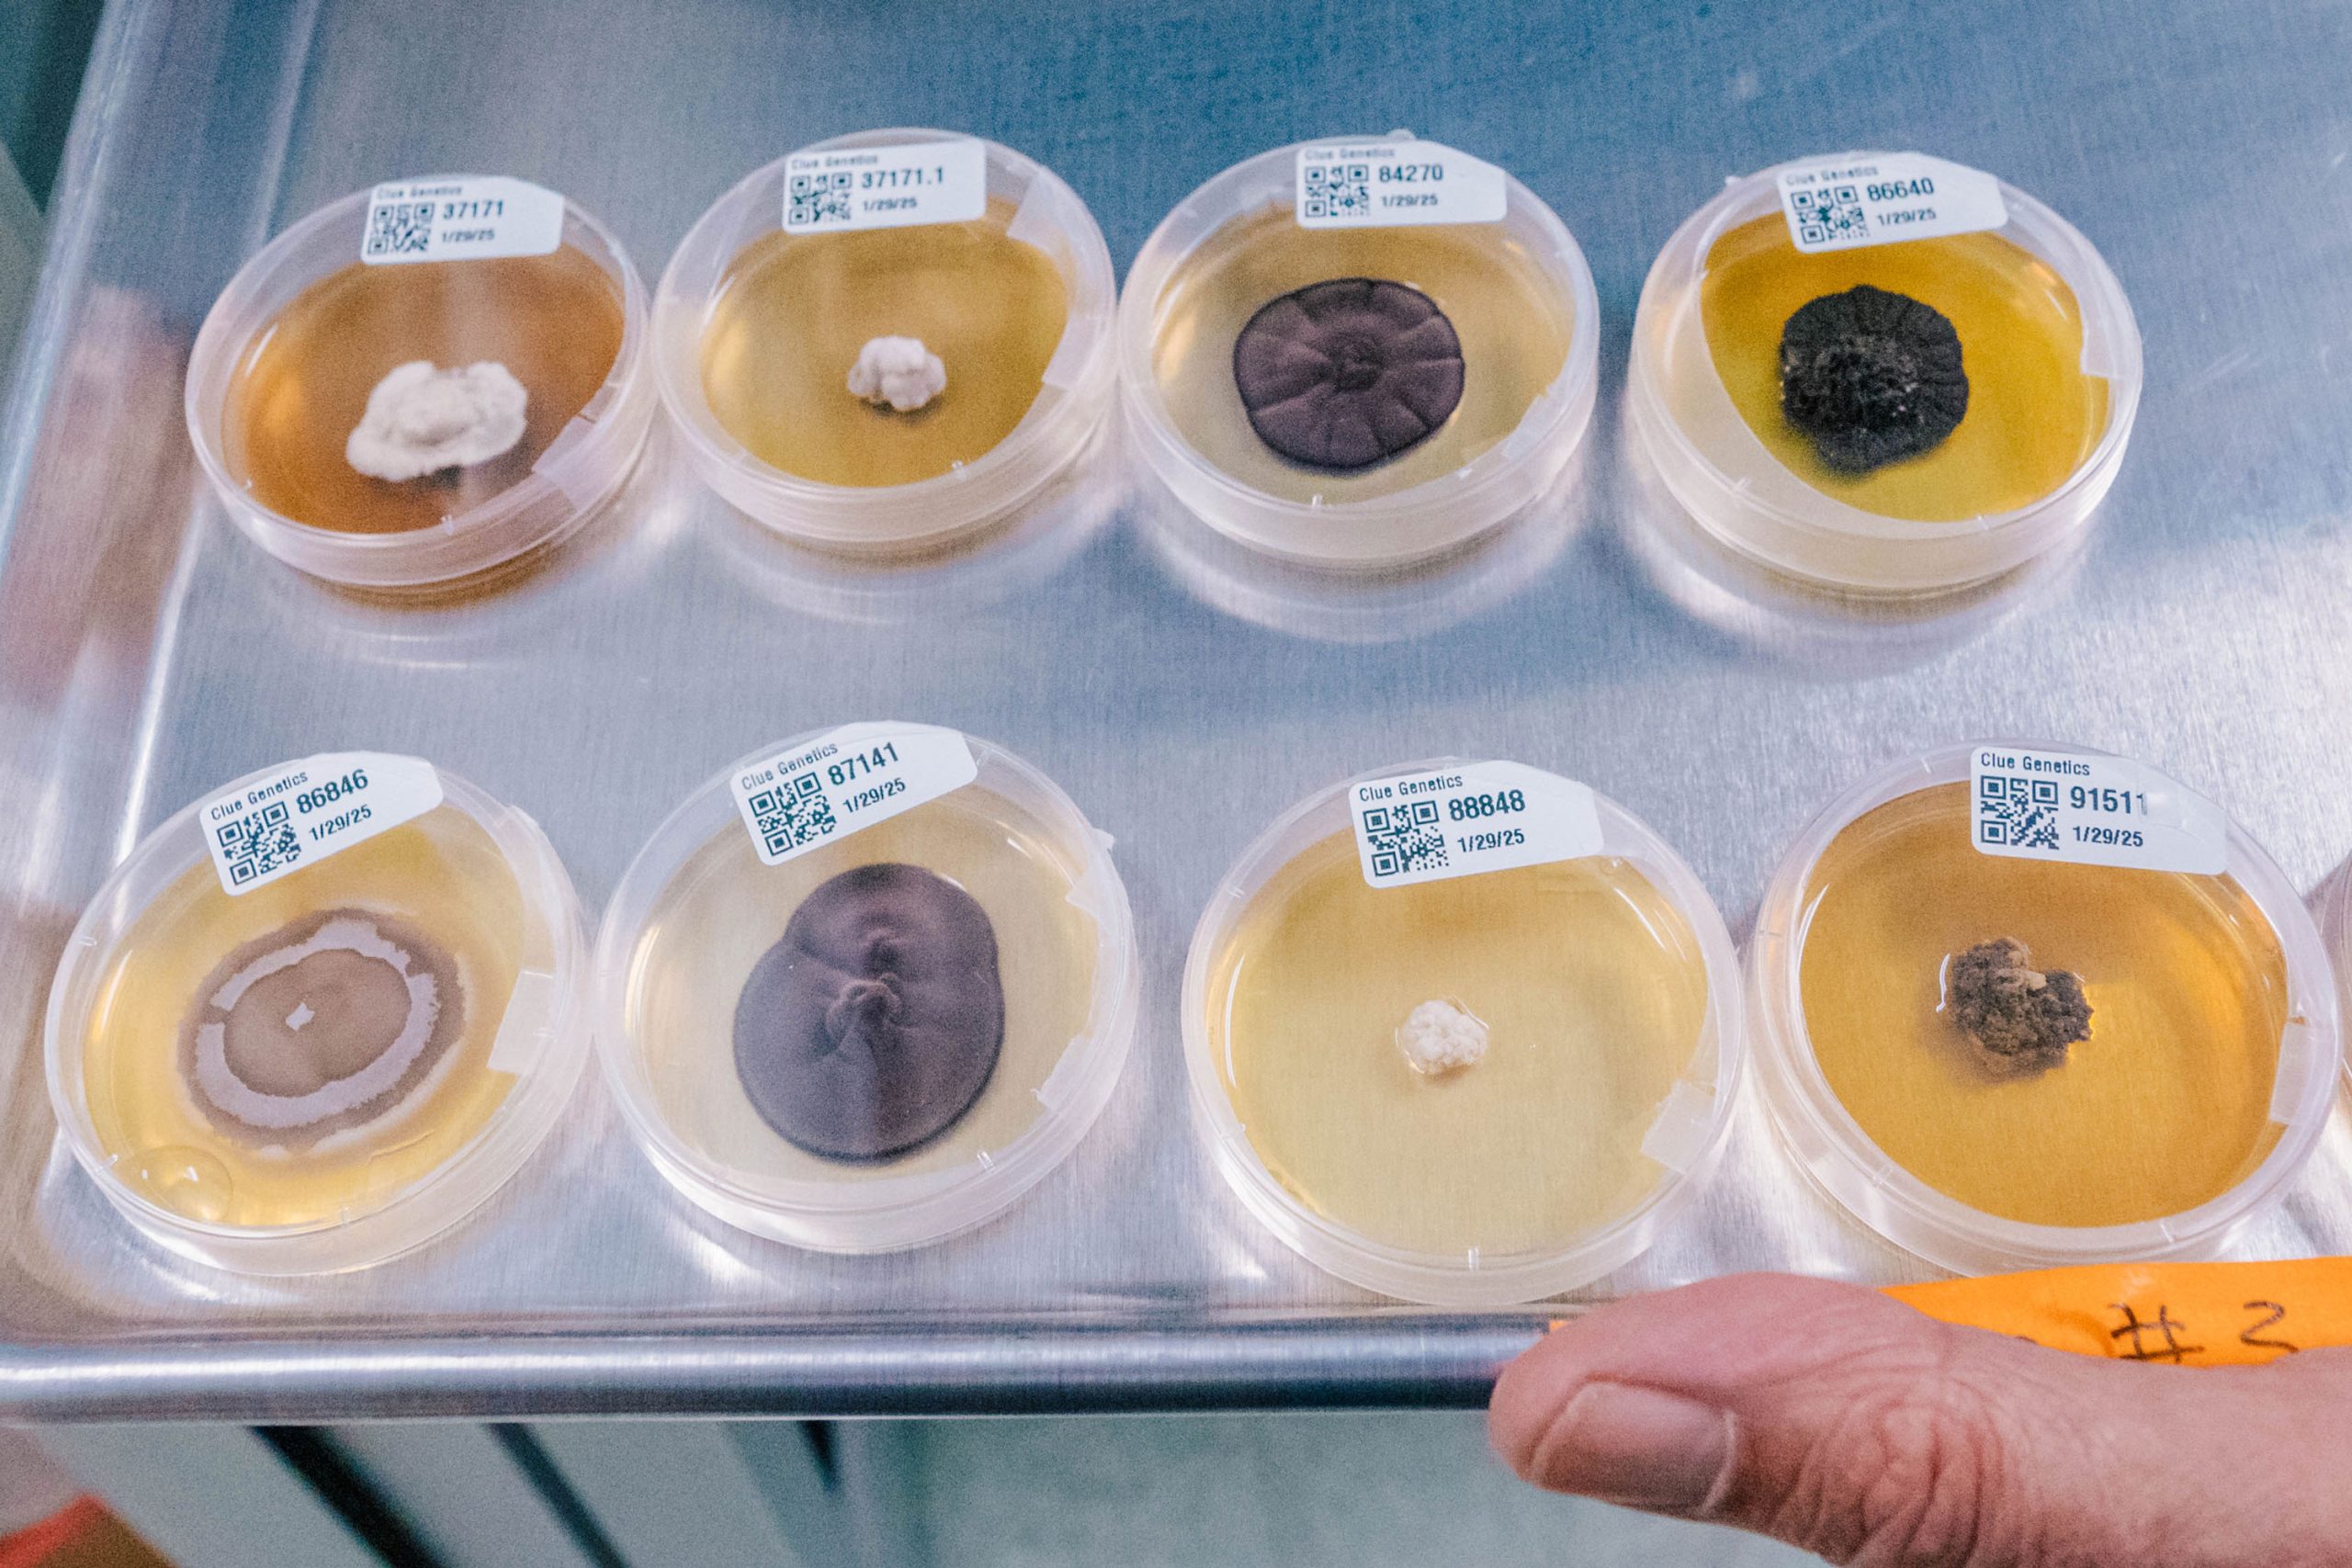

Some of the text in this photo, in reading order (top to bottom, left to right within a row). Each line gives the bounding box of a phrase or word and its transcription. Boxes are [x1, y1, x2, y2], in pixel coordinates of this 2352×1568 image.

[861, 167, 944, 189] 37171.1
[1379, 164, 1444, 183] 84270
[1785, 164, 1879, 186] Clue Genetics
[1381, 194, 1438, 208] 1/29/25
[1867, 176, 1935, 202] 86640
[443, 199, 503, 220] 37171
[863, 197, 917, 211] 1/29/25
[1877, 208, 1937, 226] 1/29/25
[441, 230, 494, 243] 1/29/25
[741, 742, 839, 791] Clue Genetics
[827, 741, 899, 786] 87141
[1981, 752, 2091, 776] Clue Genetics
[210, 771, 309, 821] Clue Genetics
[296, 768, 369, 815] 86846
[842, 777, 907, 814] 1/29/25
[1359, 775, 1463, 802] Clue Genetics
[1448, 789, 1526, 822] 88848
[309, 804, 372, 841] 1/29/25
[1457, 828, 1525, 853] 1/29/25
[2073, 826, 2143, 847] 1/29/25
[2111, 1303, 2204, 1364] #
